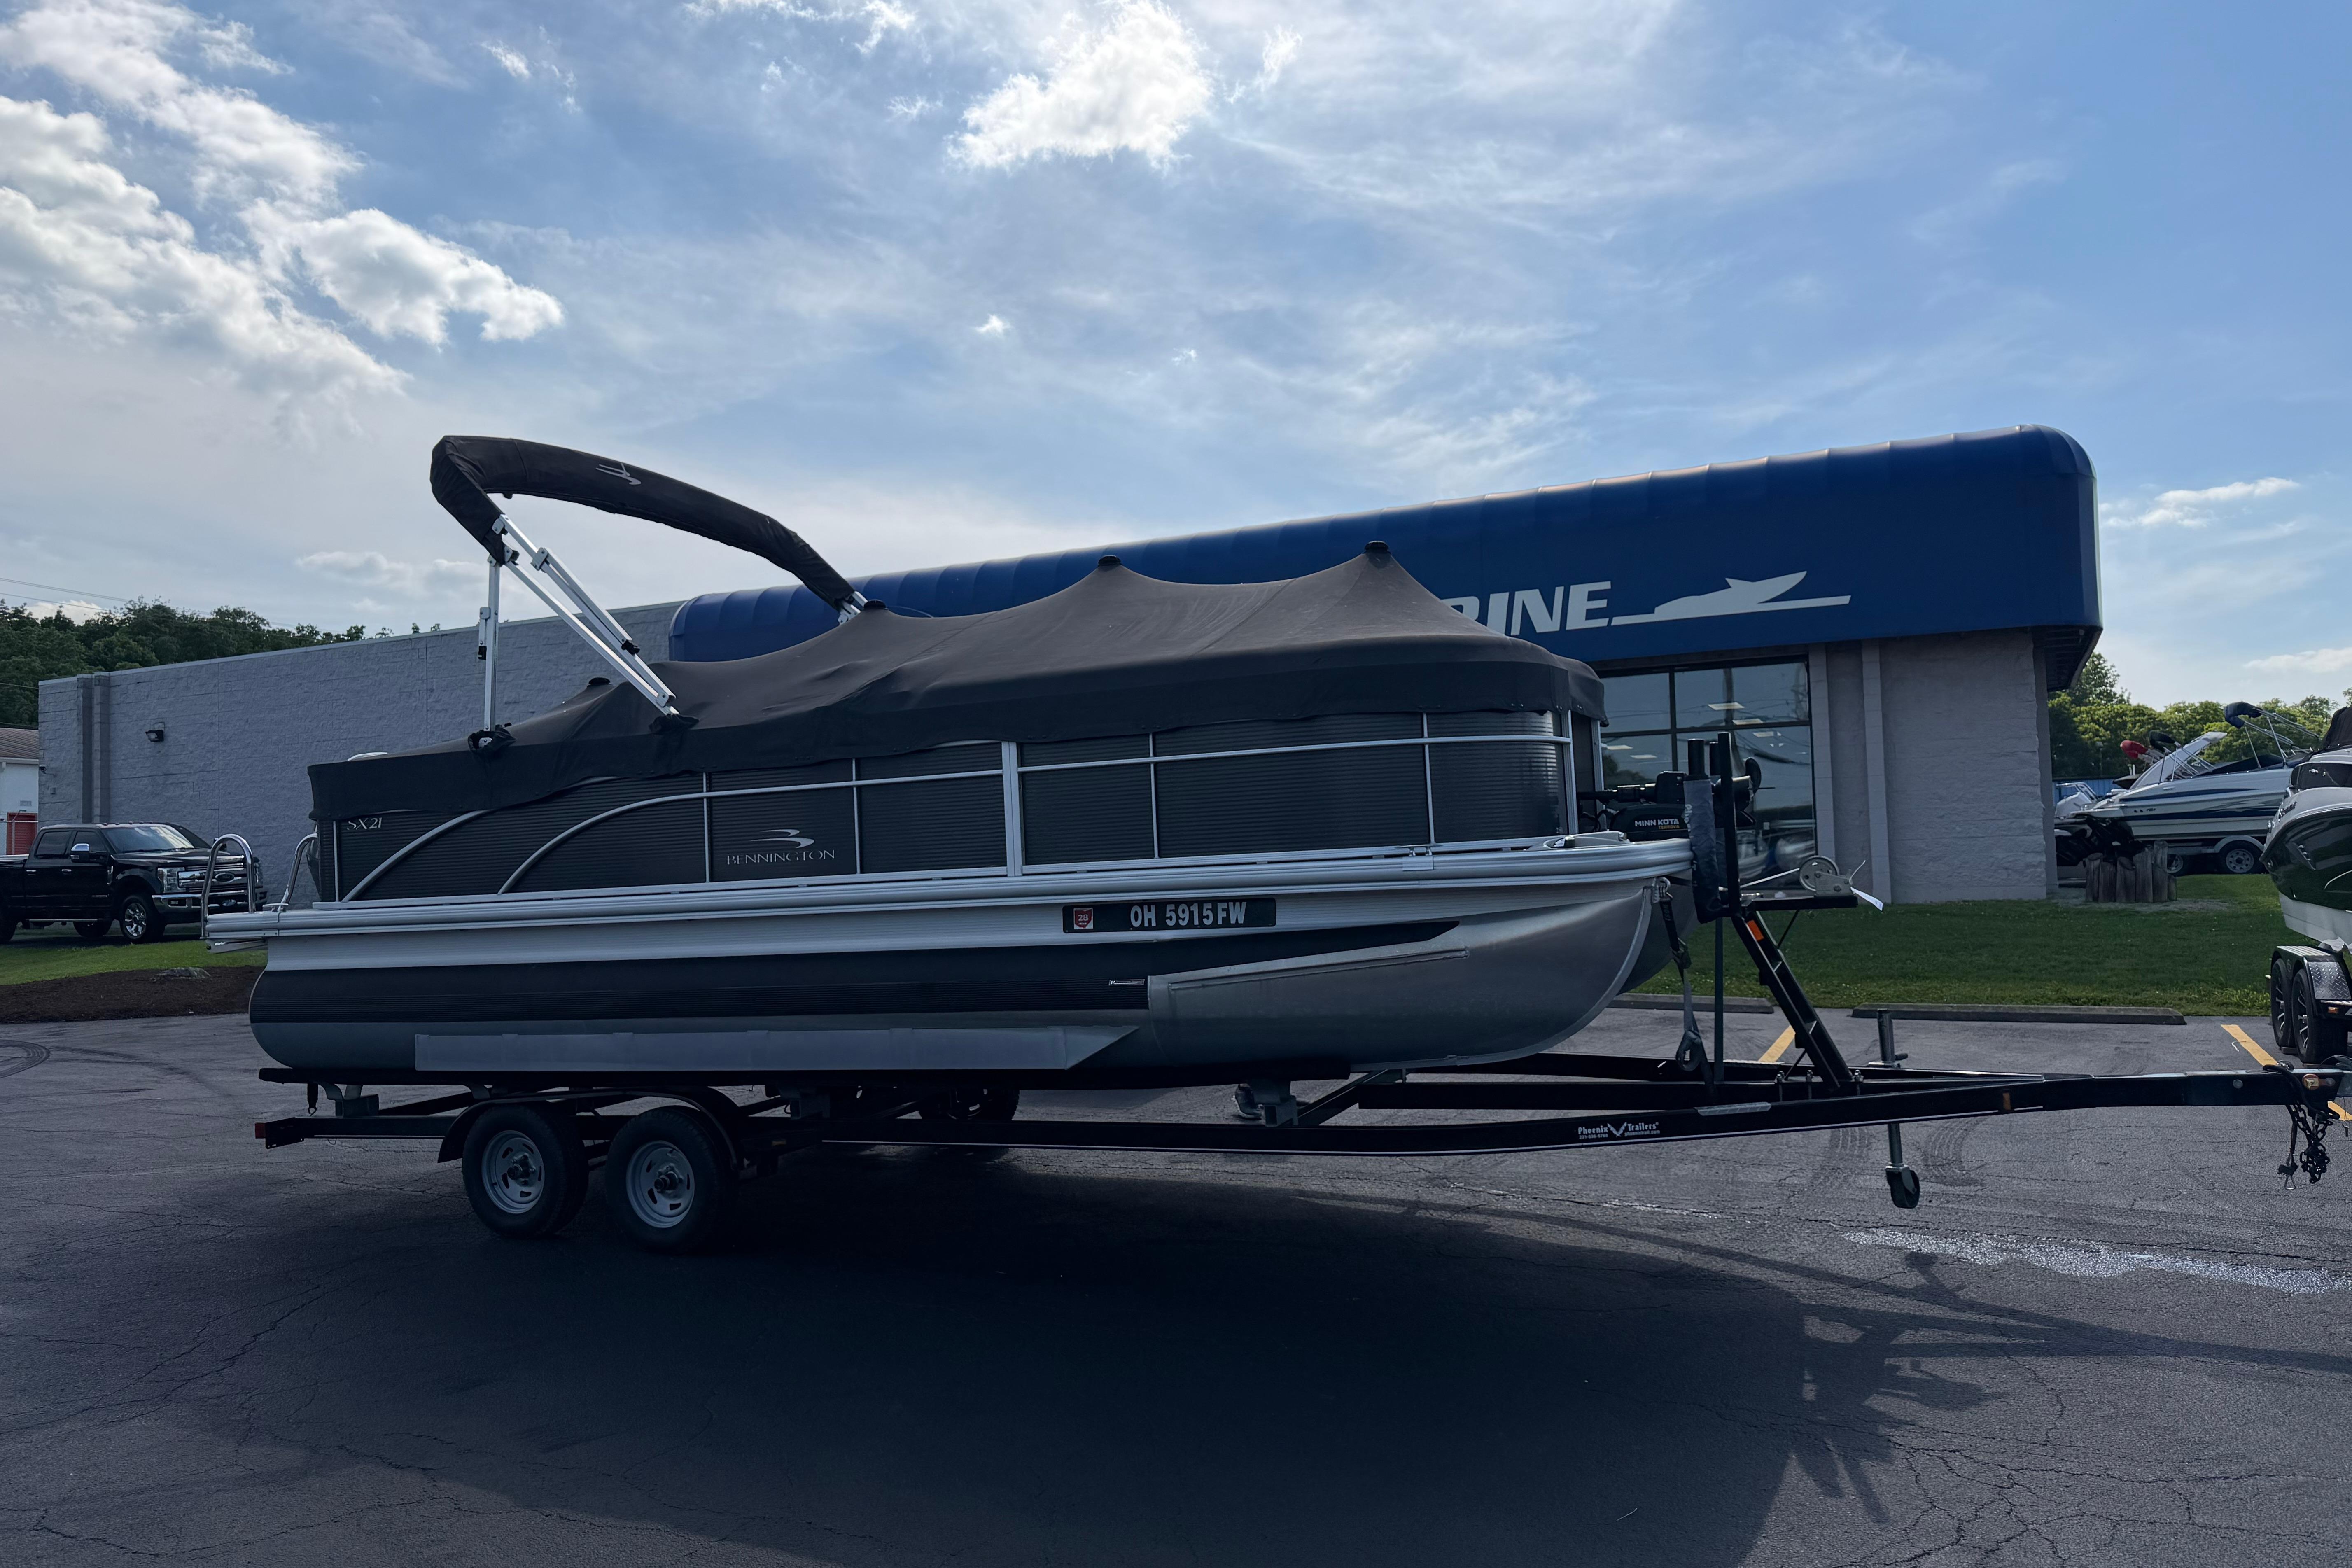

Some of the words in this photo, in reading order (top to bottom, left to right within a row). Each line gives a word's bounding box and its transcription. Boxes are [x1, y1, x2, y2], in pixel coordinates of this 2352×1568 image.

[347, 817, 383, 830] SX21
[727, 849, 835, 865] BENNINGTON
[1130, 905, 1157, 927] OH
[1165, 901, 1247, 926] 5915FW
[1577, 1125, 1608, 1135] Phoenix
